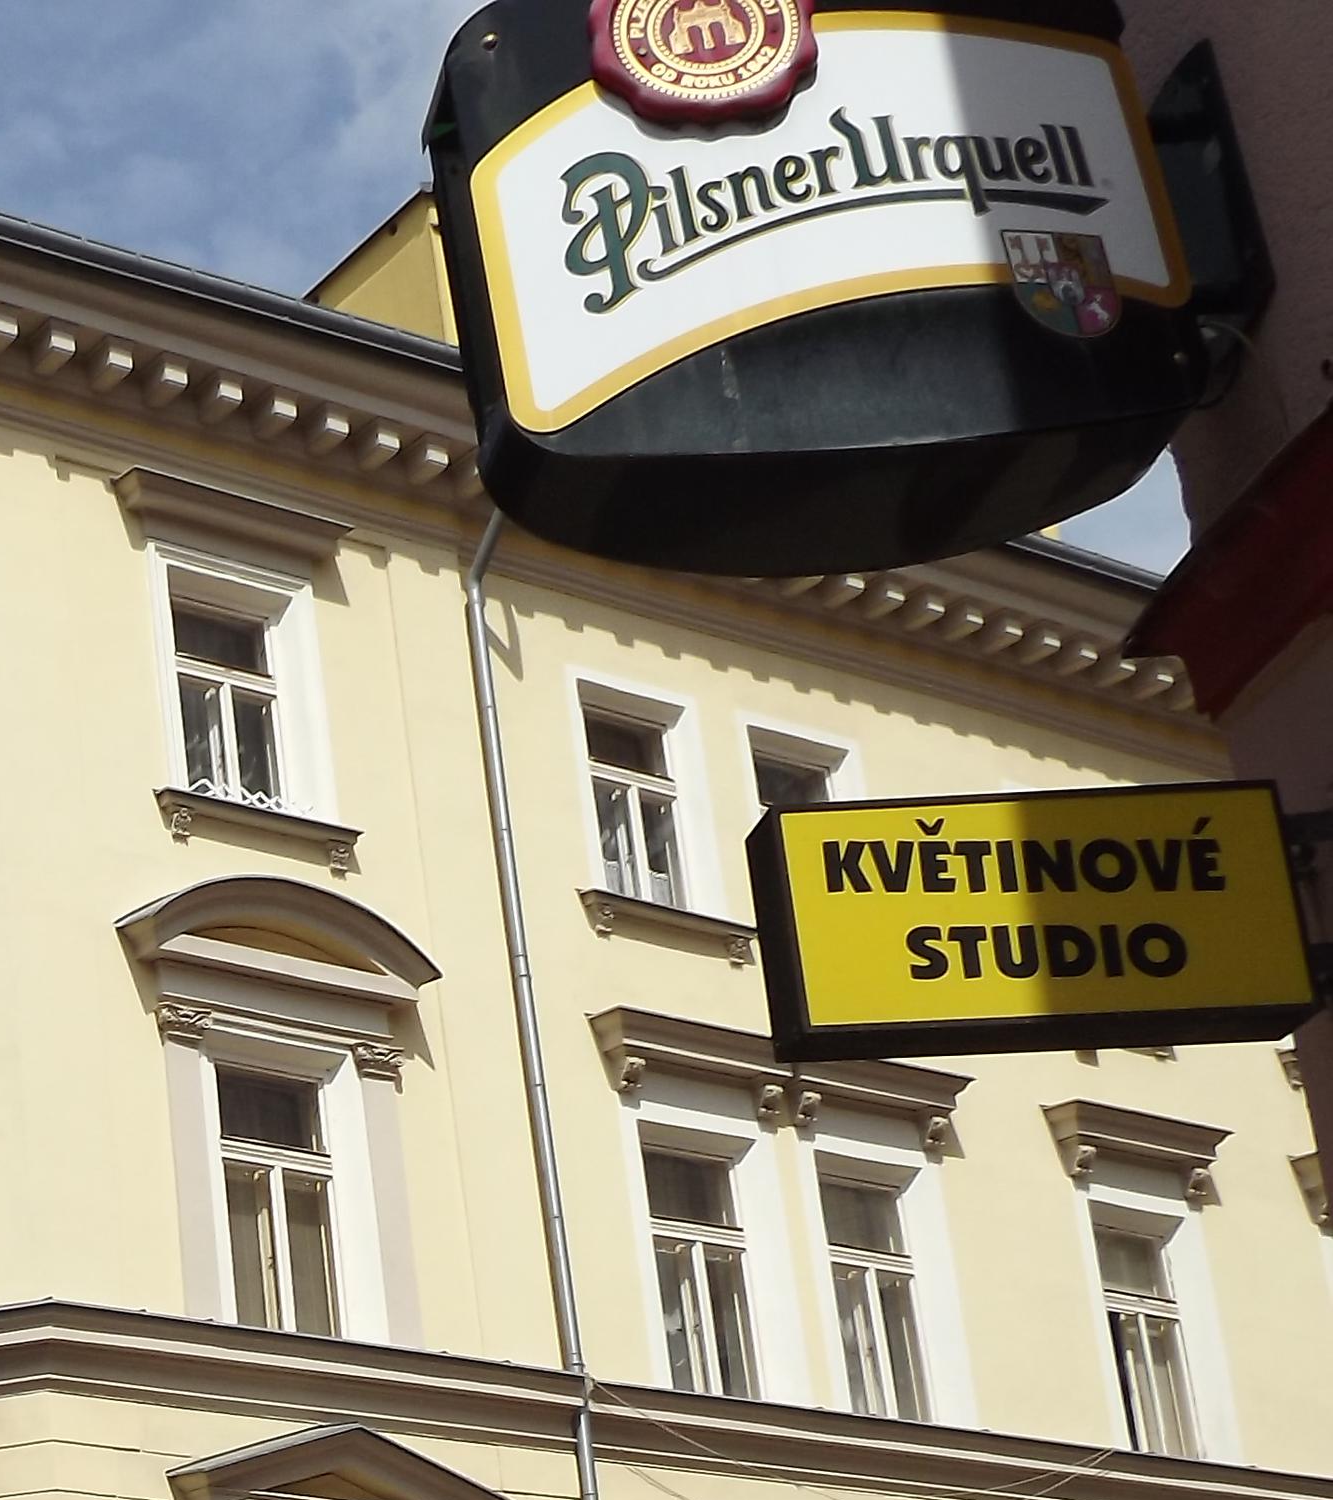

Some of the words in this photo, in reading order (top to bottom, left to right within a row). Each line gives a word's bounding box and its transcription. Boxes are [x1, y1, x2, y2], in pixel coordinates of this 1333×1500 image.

[651, 63, 678, 83] OD
[680, 73, 737, 88] ROKU
[737, 46, 776, 79] 1842
[562, 145, 841, 315] Pilsner
[831, 106, 1092, 214] Urquell
[824, 817, 1227, 894] KVĚTINOVÉ
[905, 923, 1188, 981] STUDIO
